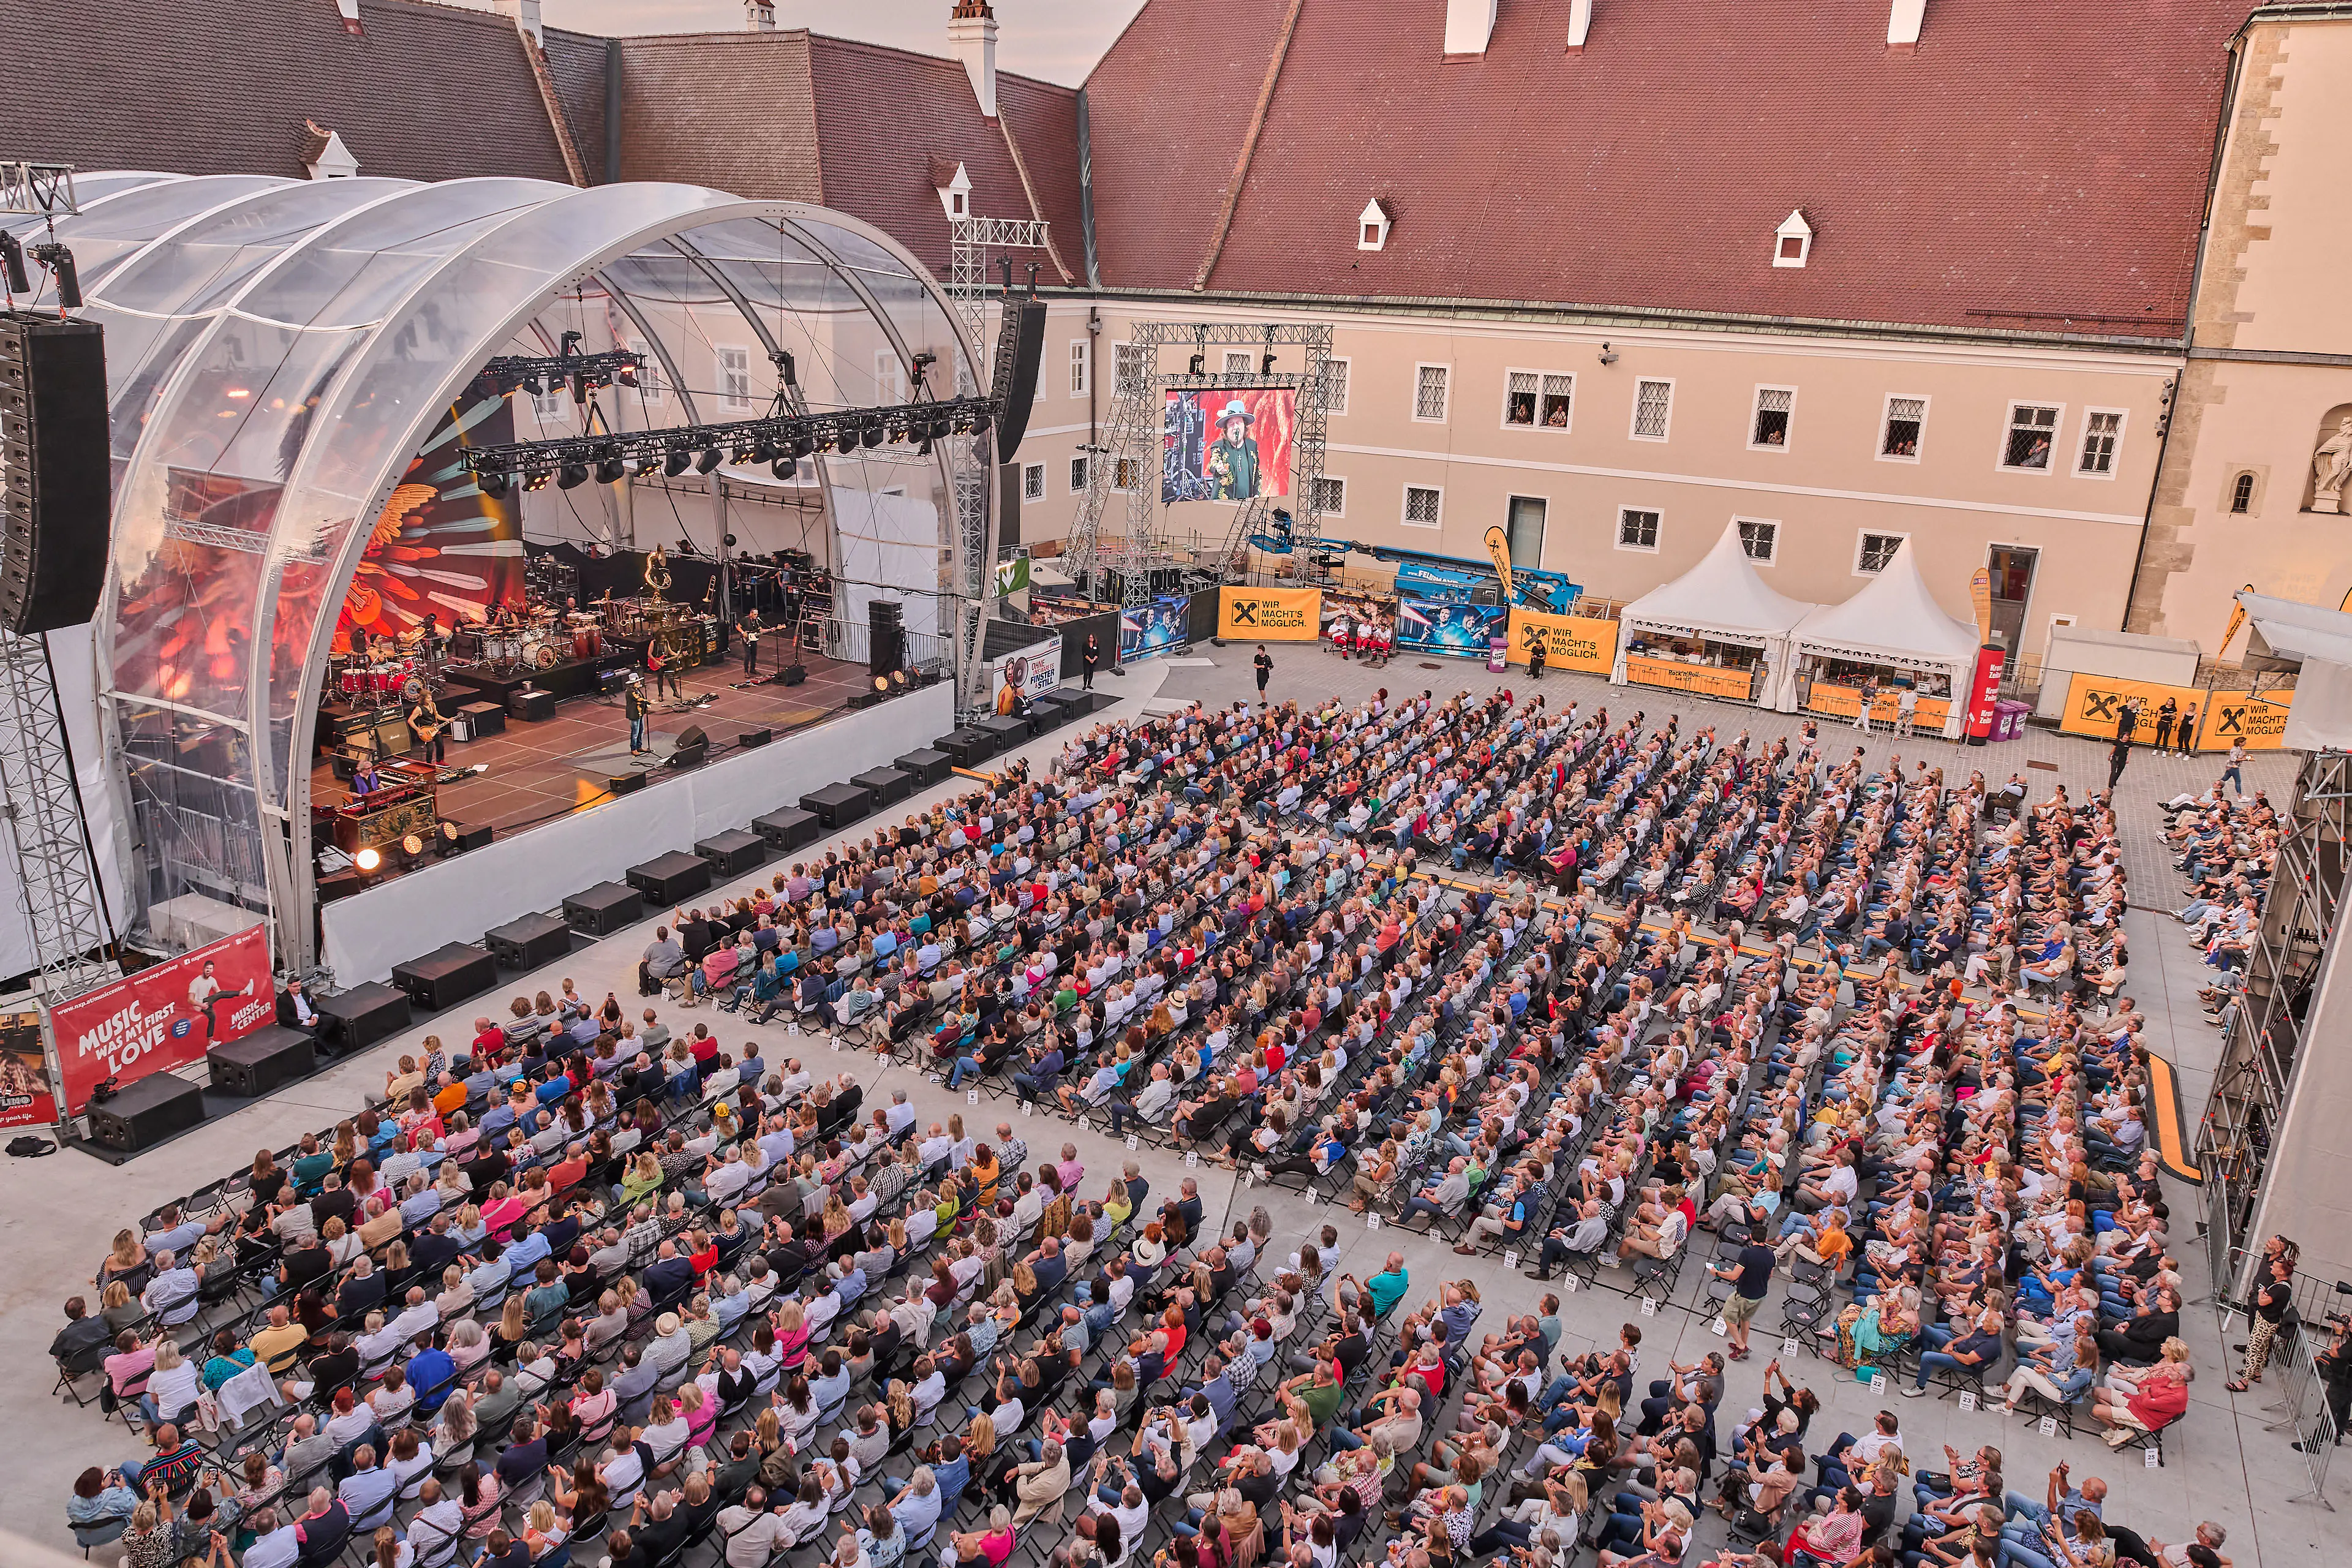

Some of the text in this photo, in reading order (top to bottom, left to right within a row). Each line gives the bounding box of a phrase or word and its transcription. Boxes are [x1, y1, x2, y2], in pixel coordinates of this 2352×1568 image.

[1404, 601, 1441, 610] LASERTRON
[1123, 608, 1148, 616] LASERTRON
[1261, 617, 1306, 627] MÖGLICH.
[1553, 628, 1572, 637] WIR
[1552, 638, 1596, 649] MACHT'S
[1550, 646, 1600, 659] MÖGLICH.
[1031, 659, 1045, 671] OHNE
[1030, 669, 1055, 684] FINSTER
[1038, 677, 1054, 688] STILL
[2250, 705, 2268, 714] WIR
[57, 984, 126, 1016] www.nxp.at/musiccenter
[134, 963, 178, 986] www.nxp.at/shop
[191, 943, 230, 963] nxpmusiccenter
[231, 998, 260, 1025] MUSIC
[237, 1001, 272, 1030] CENTER
[79, 1000, 142, 1058] MUSIC
[95, 1035, 123, 1060] WAS
[126, 1020, 142, 1042] MY
[144, 1001, 175, 1028] FIRST
[108, 1022, 165, 1076] LOVE
[0, 1096, 31, 1107] LING
